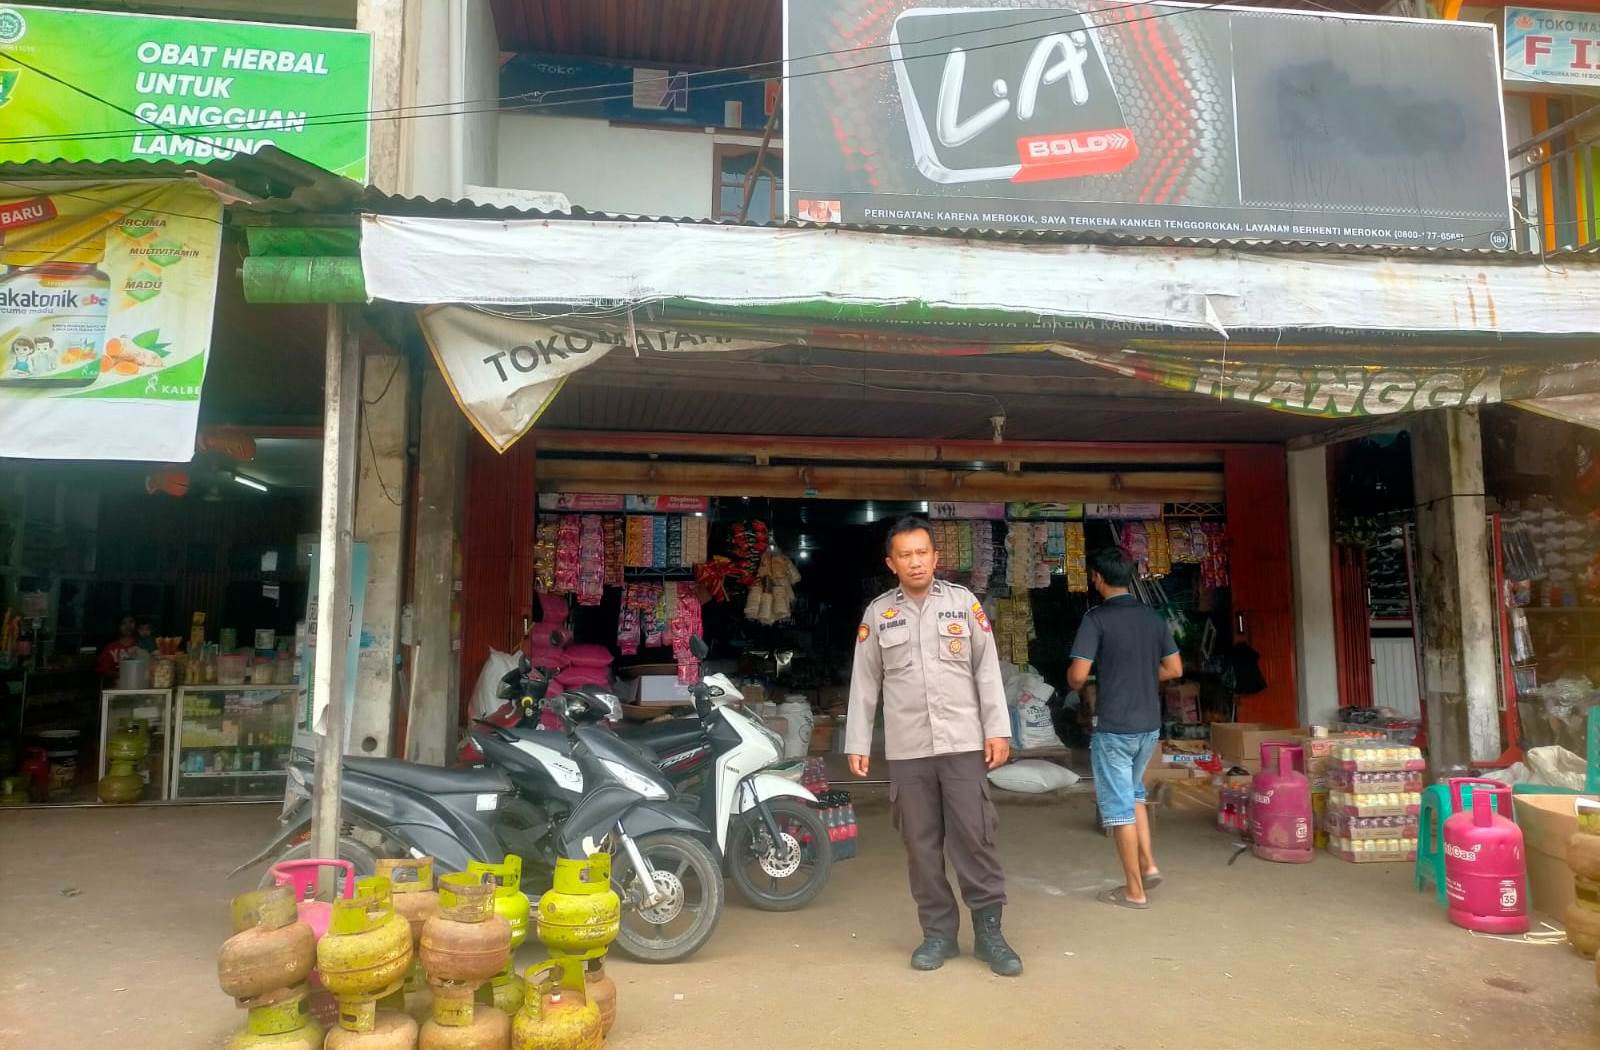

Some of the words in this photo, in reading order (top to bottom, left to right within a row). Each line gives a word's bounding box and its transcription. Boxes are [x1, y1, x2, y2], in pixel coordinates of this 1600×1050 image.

[1536, 18, 1575, 32] TOKO
[136, 41, 218, 69] OBAT
[221, 48, 329, 76] HERBAL
[134, 71, 234, 99] UNTUK
[133, 102, 307, 133] GANGGUAN
[1028, 136, 1107, 158] BOLD
[1, 204, 44, 225] BARU
[118, 216, 167, 228] URCUMA
[864, 208, 934, 220] PERINGATAN:
[936, 211, 980, 222] KARENA
[982, 213, 1038, 225] MEROKOK,
[1040, 215, 1067, 225] SAYA
[1069, 216, 1117, 226] TERKENA
[1120, 218, 1161, 228] KANKER
[1245, 223, 1290, 233] LAYANAN
[1292, 225, 1341, 235] BERHENTI
[1343, 227, 1392, 237] MEROKOK
[128, 247, 200, 258] MULTIVITAMIN
[125, 280, 163, 290] MADU
[483, 328, 593, 383] TOKO
[938, 610, 967, 620] POLRI
[1503, 895, 1515, 905] 35
